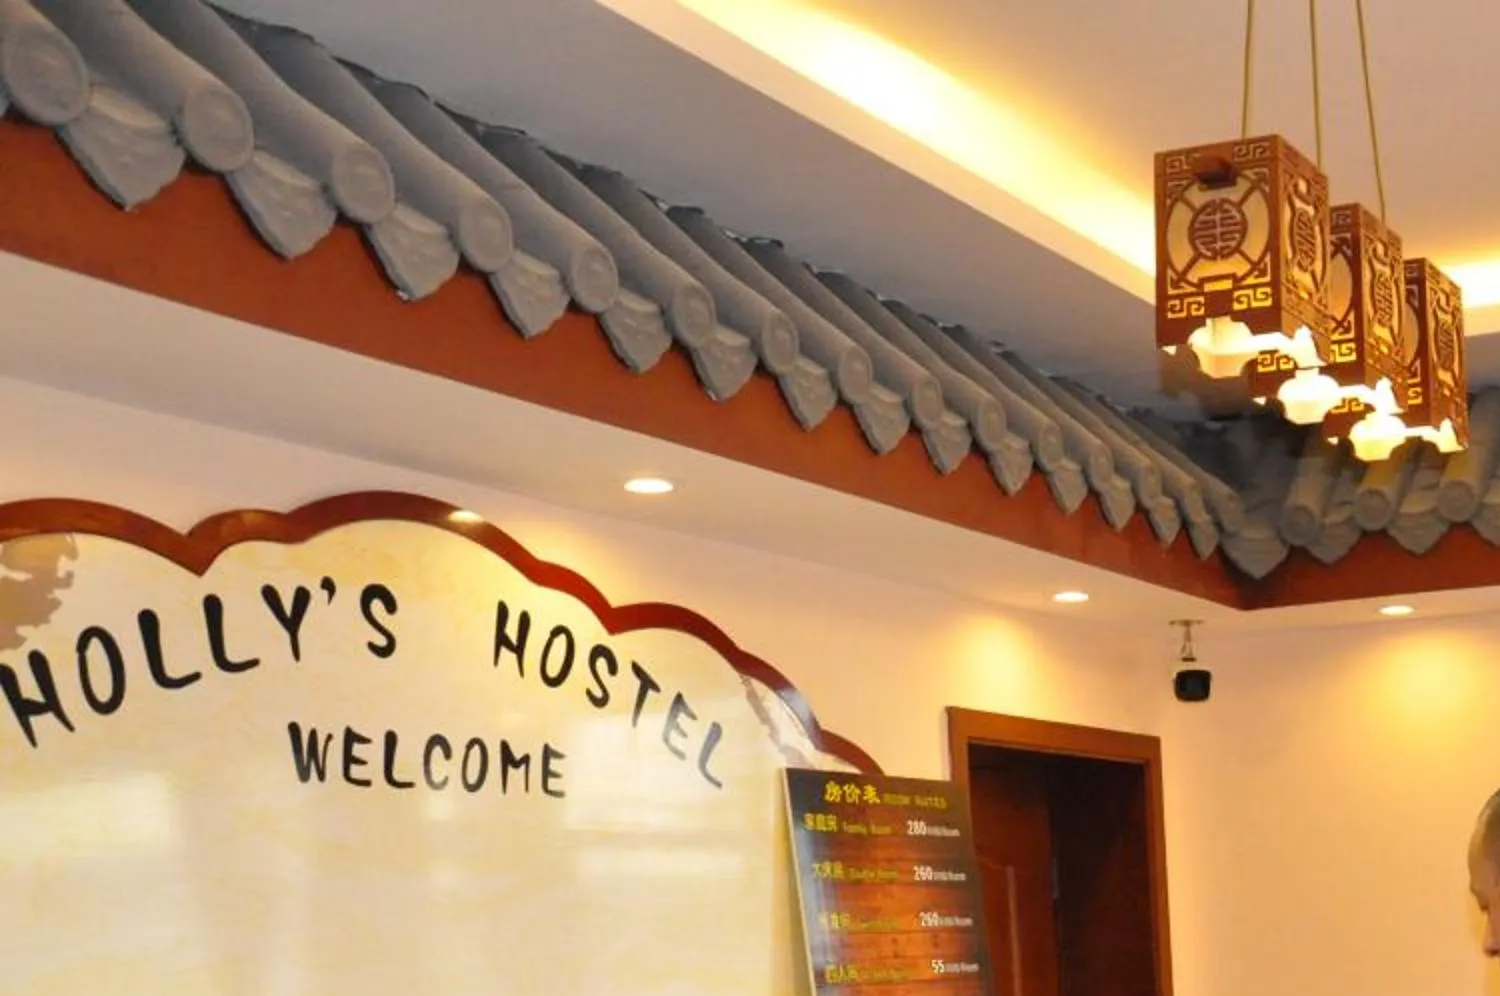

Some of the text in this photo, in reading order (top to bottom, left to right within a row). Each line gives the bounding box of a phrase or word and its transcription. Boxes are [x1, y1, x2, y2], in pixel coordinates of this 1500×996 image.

[0, 576, 723, 789] HOLLY'S HOSTEL
[287, 721, 566, 798] WELCOME
